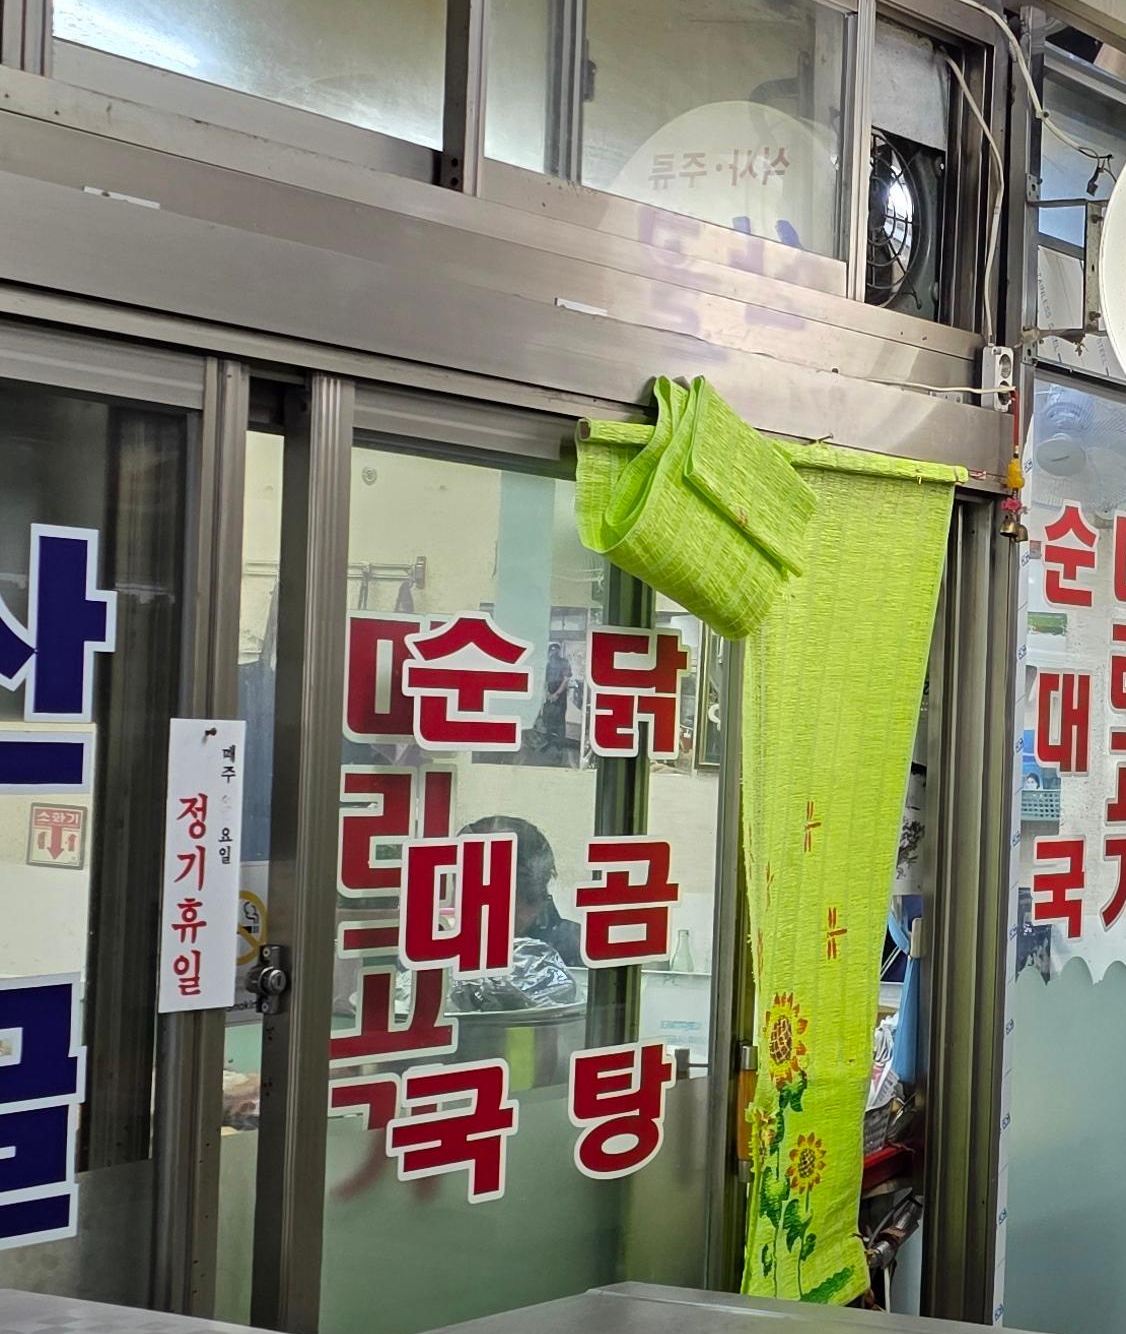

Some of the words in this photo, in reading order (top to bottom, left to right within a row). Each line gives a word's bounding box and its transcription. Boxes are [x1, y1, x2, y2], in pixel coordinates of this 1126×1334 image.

[37, 810, 79, 826] 소화기
[171, 793, 209, 996] 정기휴일
[391, 616, 532, 1199] 순대국
[571, 631, 688, 1175] 닭곰탕
[1033, 505, 1096, 940] 순대국
